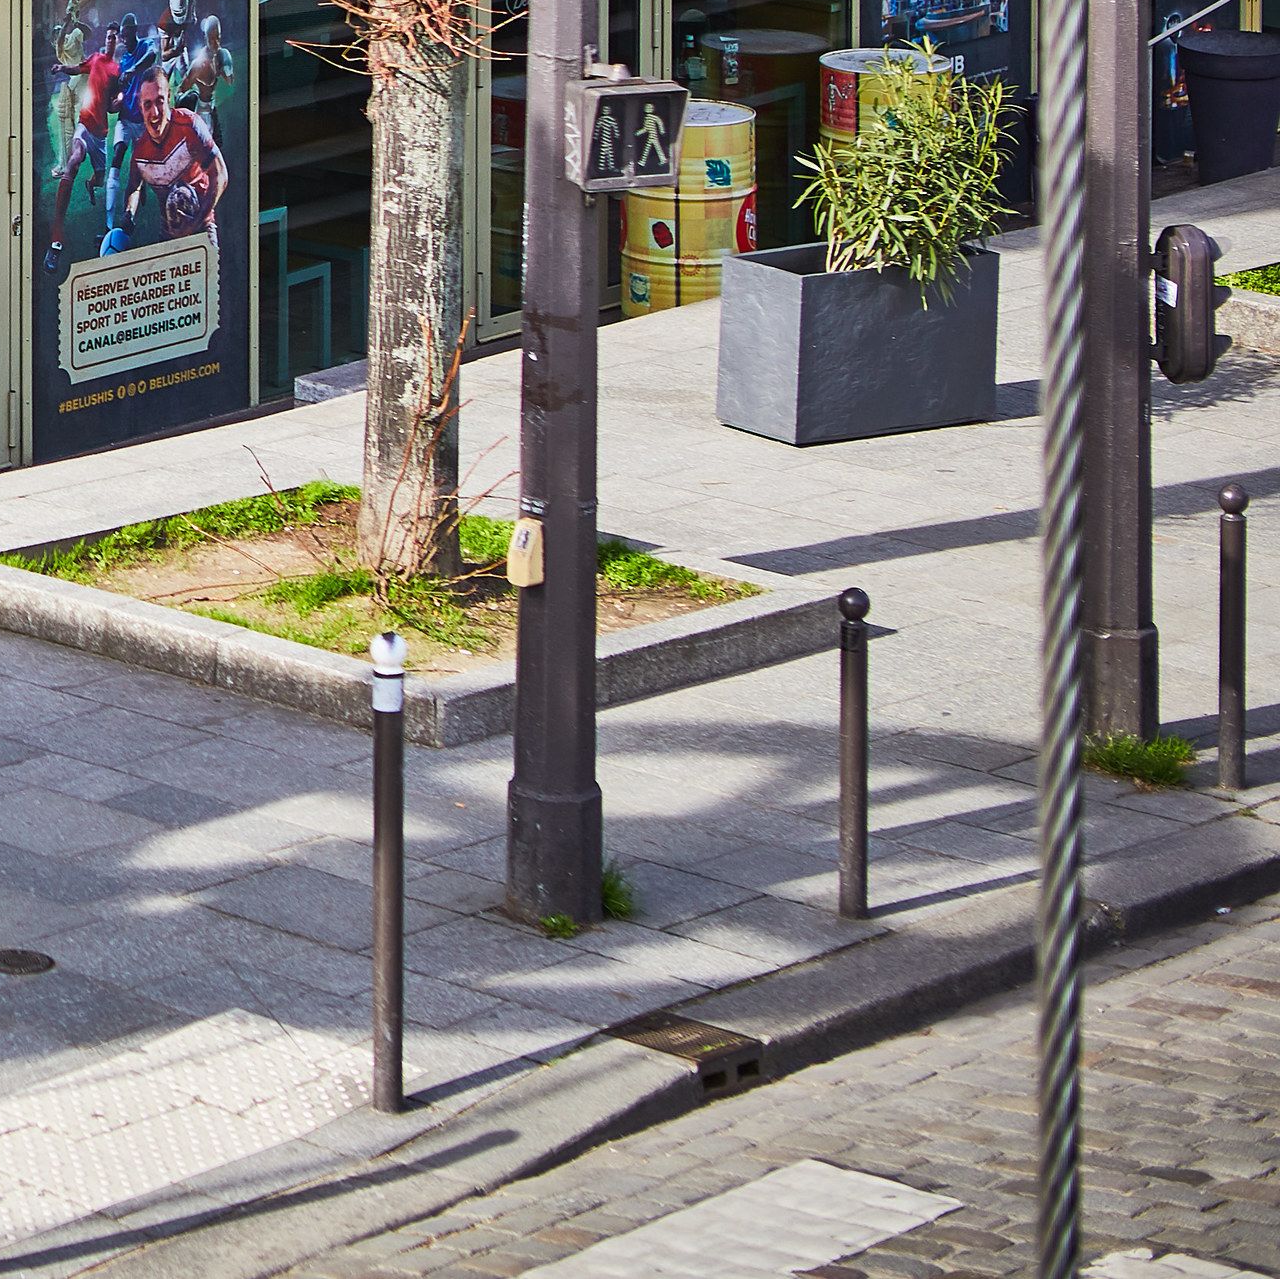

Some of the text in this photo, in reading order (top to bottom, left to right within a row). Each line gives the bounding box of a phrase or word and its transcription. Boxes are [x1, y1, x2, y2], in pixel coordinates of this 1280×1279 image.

[77, 261, 201, 302] RÉSERVEZ VOTRE TABLE
[87, 279, 191, 315] POUR REGARDER LE
[76, 292, 202, 334] SPORT DE VOTRE CHOIX.
[78, 312, 202, 353] CANAL@BELUSHIS.COM
[58, 362, 220, 413] #BELUSHIS BELUSHIS.COM
